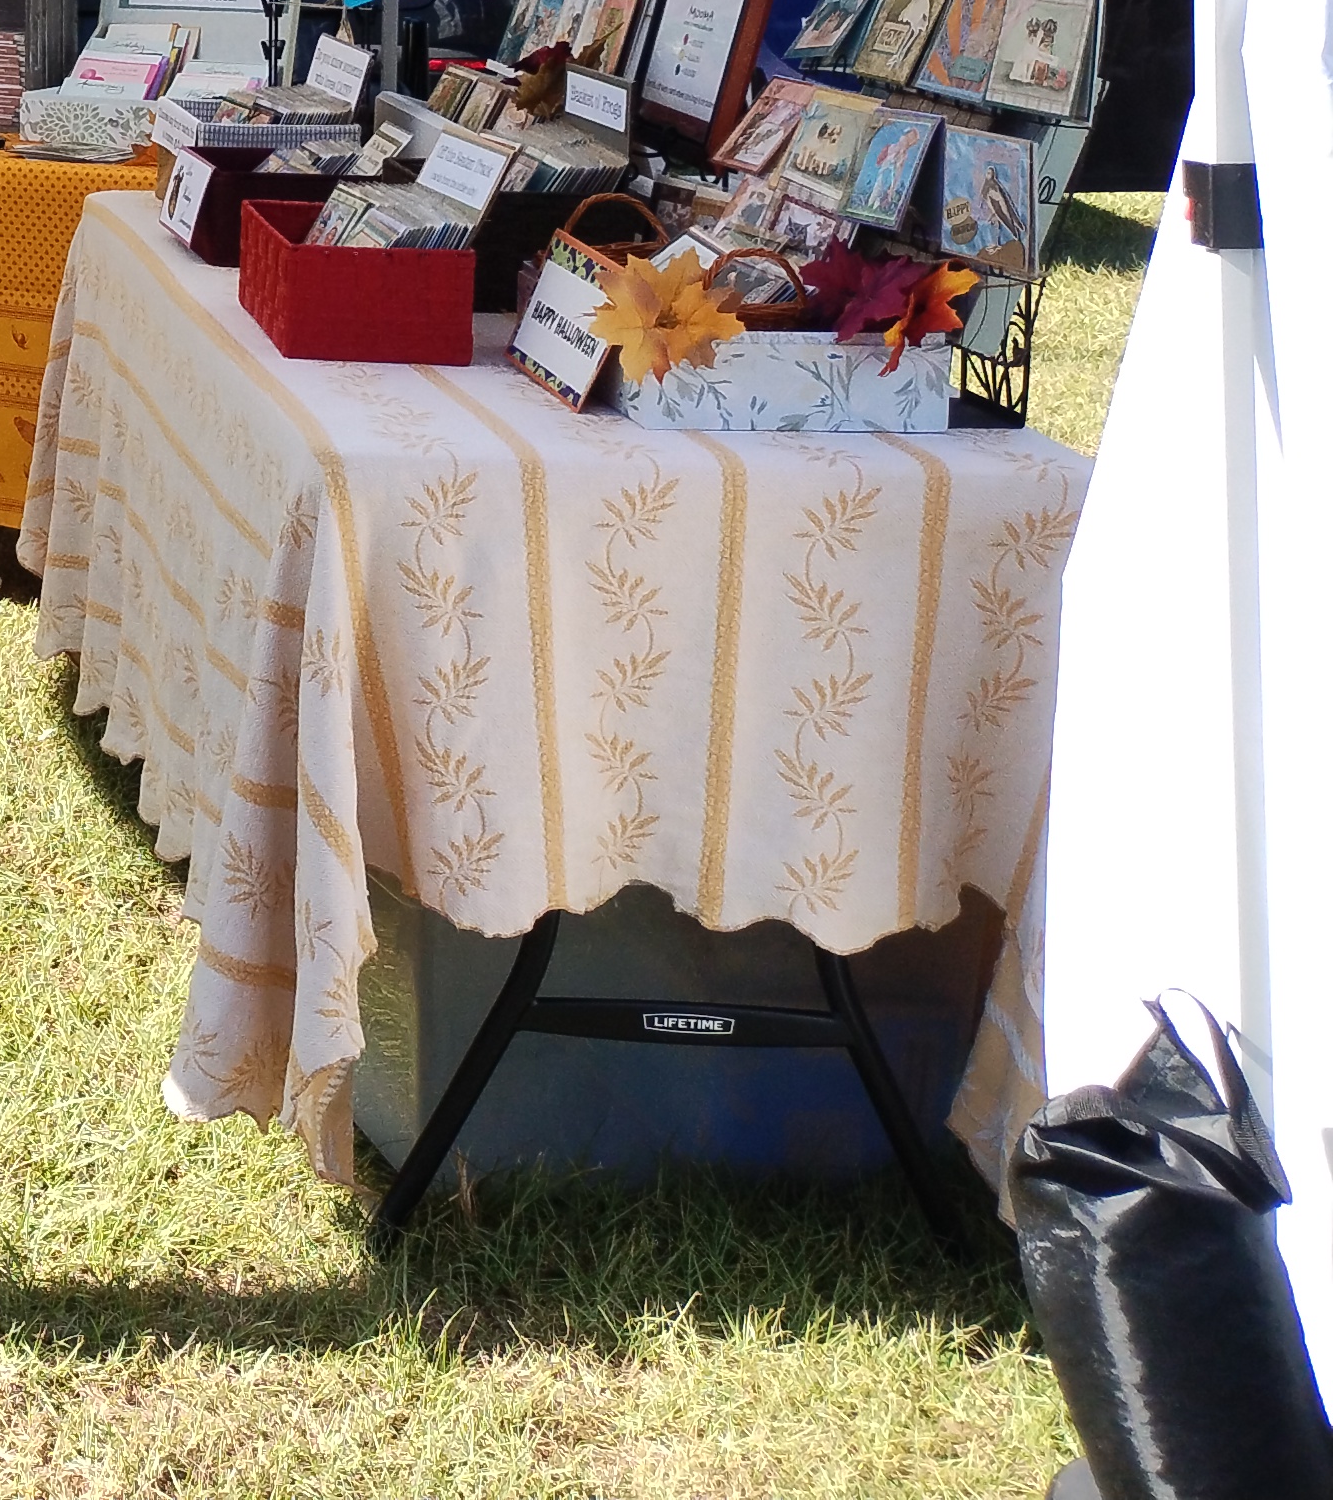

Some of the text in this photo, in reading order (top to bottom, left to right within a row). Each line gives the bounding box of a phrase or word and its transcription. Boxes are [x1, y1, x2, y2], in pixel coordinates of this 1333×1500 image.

[531, 300, 600, 359] HAPPY HALLOWEEN
[654, 1016, 725, 1030] LIFETIME
